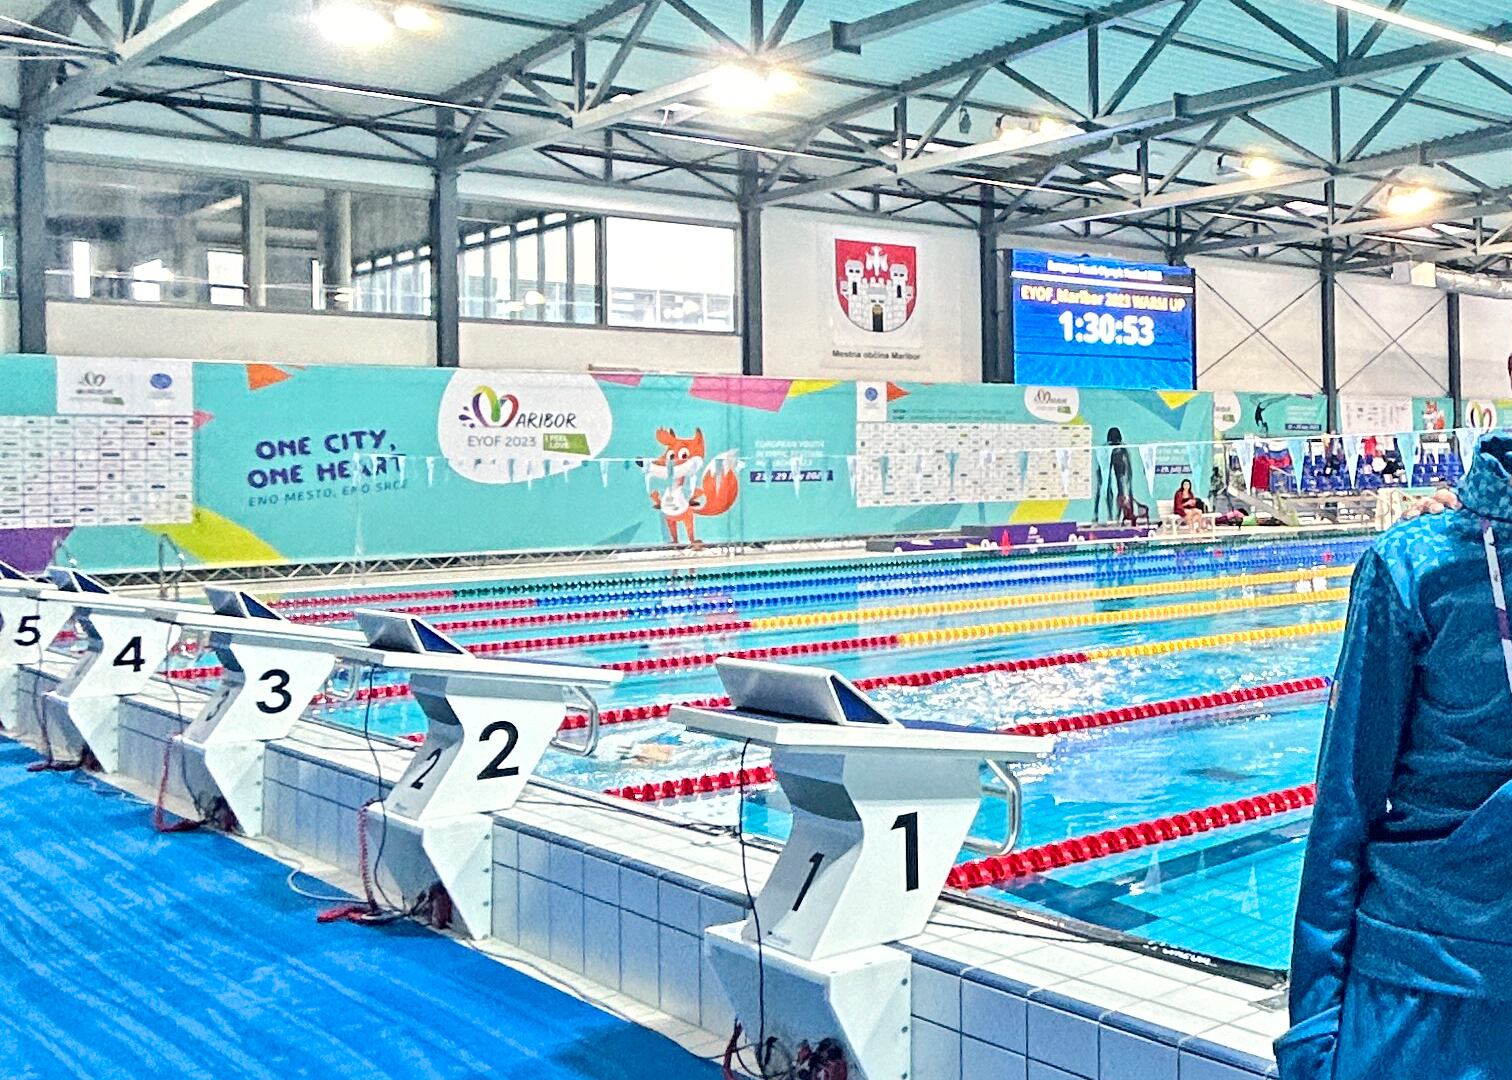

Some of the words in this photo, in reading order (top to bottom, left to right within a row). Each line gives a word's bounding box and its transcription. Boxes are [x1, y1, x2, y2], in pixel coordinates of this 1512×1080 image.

[1058, 310, 1155, 346] 1:30:53
[255, 437, 312, 460] ONE
[467, 435, 502, 447] EYOF
[505, 436, 537, 447] 2023
[247, 465, 304, 489] ONE
[248, 494, 279, 507] ENO
[14, 615, 41, 646] 5
[113, 636, 145, 672] 4
[255, 669, 292, 713] 3
[477, 721, 519, 780] 2
[410, 749, 442, 789] 2
[890, 811, 920, 891] 1
[791, 852, 826, 911] 1
